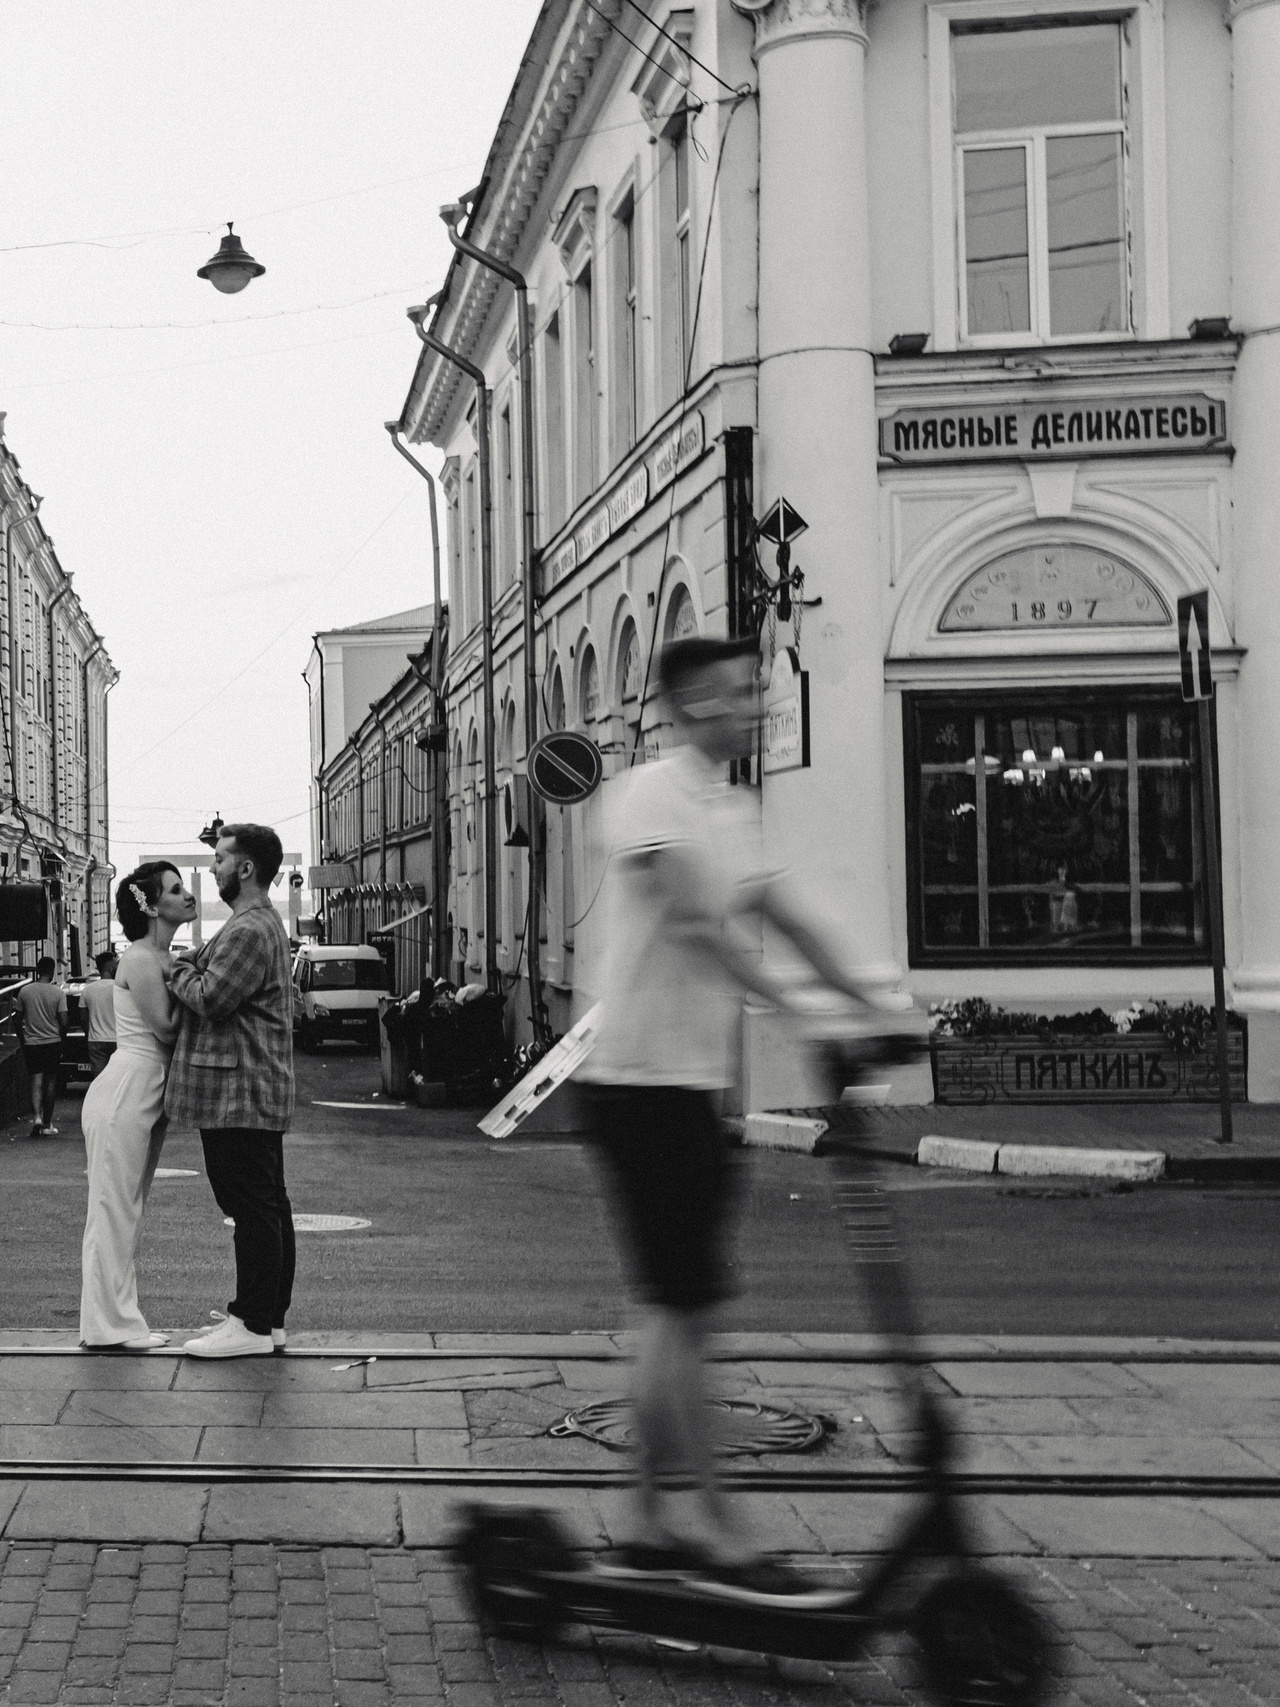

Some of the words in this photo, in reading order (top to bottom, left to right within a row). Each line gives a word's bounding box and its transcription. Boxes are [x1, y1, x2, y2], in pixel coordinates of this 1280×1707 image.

[894, 415, 1018, 451] МЯСНЫЕ
[1031, 404, 1216, 449] ДЕЛИКАТЕСЫ
[1010, 600, 1098, 622] 1897
[1015, 1053, 1167, 1089] ПЯТКИНЪ
